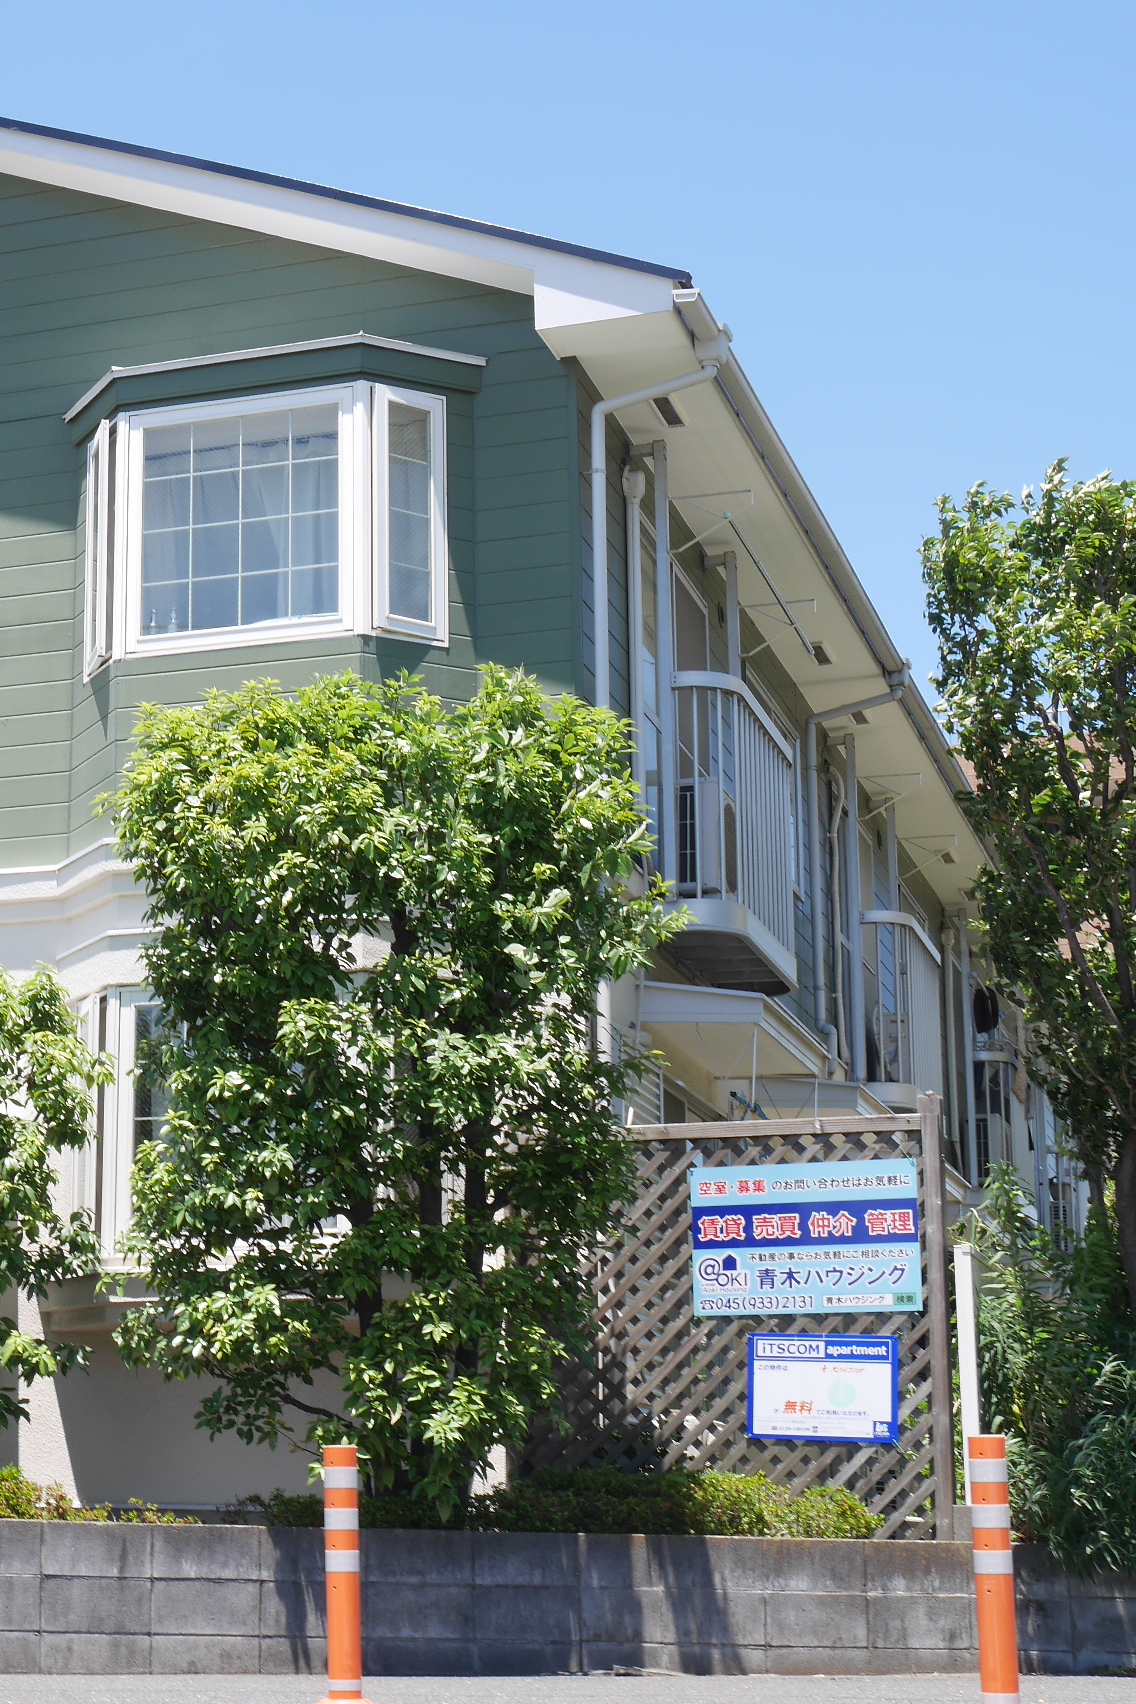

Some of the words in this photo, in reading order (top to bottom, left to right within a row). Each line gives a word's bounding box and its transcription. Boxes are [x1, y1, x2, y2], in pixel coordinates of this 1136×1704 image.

[698, 1179, 766, 1196] 空室・募集
[771, 1174, 911, 1191] のお問い合わせはお気軽に
[698, 1215, 746, 1241] 賃貸
[753, 1213, 802, 1239] 売買
[808, 1211, 857, 1237] 仲介
[864, 1209, 915, 1235] 管理
[748, 1248, 915, 1262] 不動産の事ならお気軽にご相談ください
[756, 1263, 907, 1290] 青木ハウジング
[715, 1295, 814, 1311] 045(933)2131
[825, 1295, 885, 1306] 青木ハウジング
[762, 1342, 820, 1355] iTSCOM
[826, 1344, 888, 1356] apartment
[783, 1399, 813, 1415] 無料
